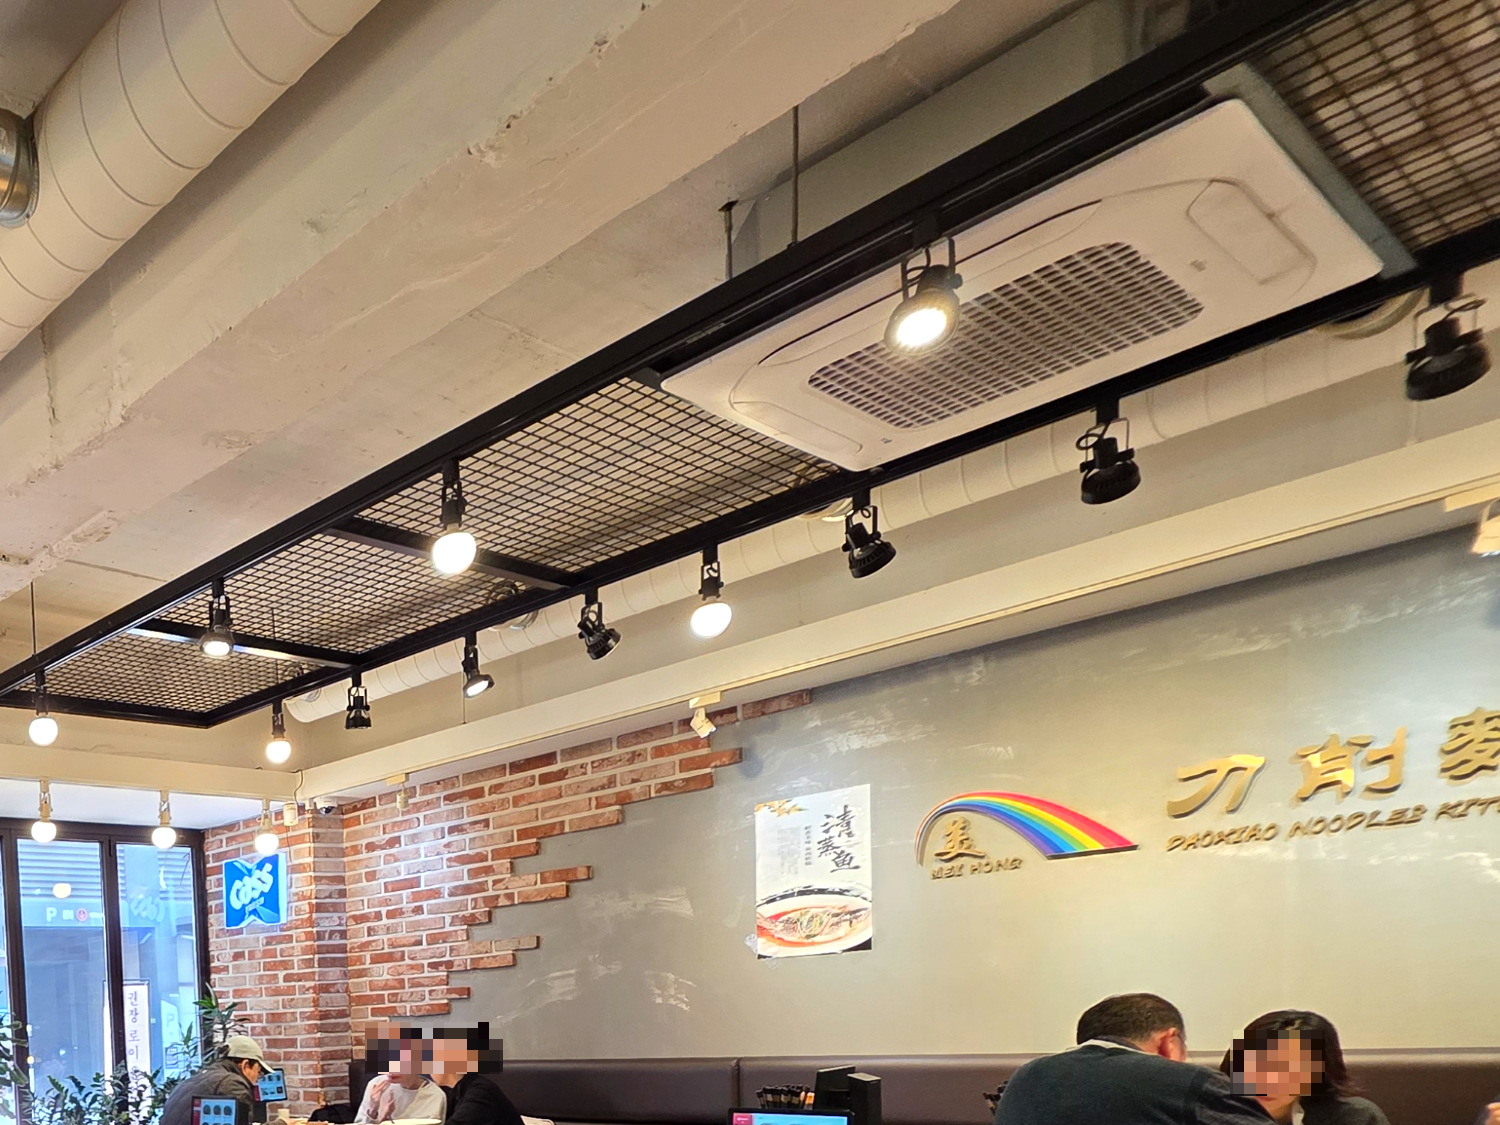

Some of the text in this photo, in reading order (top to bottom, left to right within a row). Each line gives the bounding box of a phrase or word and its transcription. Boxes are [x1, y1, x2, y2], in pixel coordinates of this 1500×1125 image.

[1166, 795, 1500, 852] DAOXIAO NOODLES KIT
[929, 857, 1023, 880] MEI HONG
[46, 907, 57, 922] P
